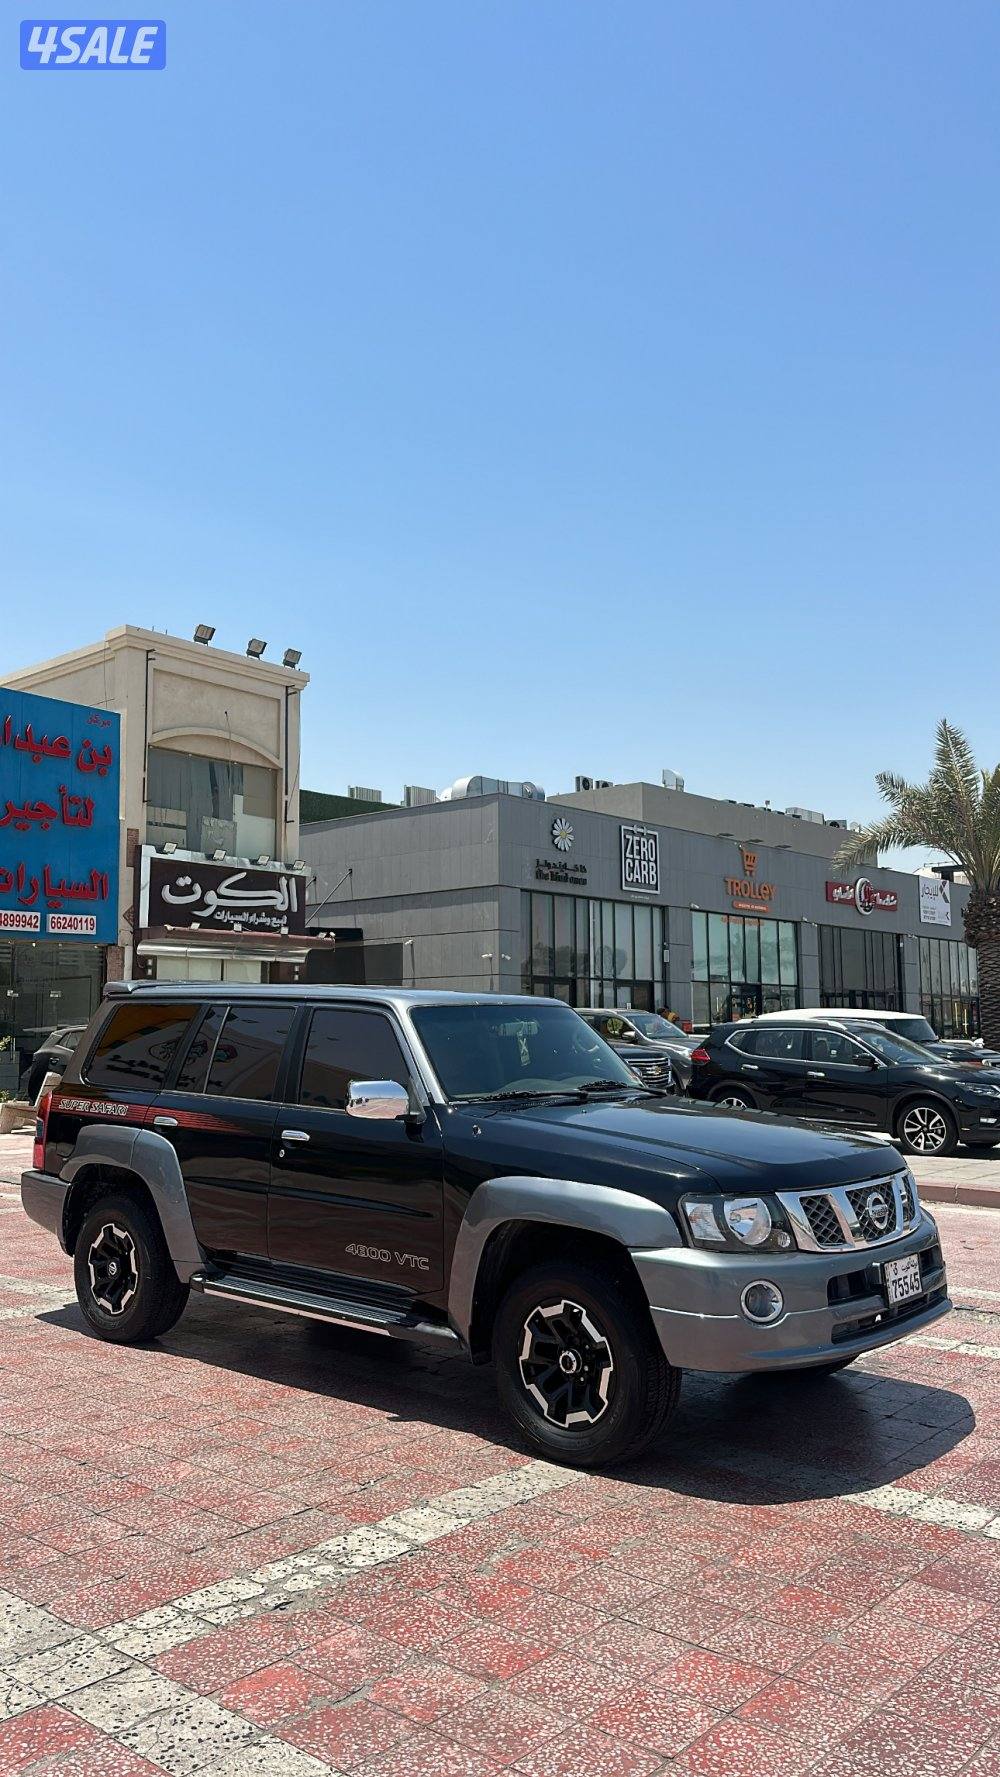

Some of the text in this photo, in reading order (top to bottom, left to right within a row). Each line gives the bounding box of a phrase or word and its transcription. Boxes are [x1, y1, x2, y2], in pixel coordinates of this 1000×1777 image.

[0, 714, 113, 776] بن عبدا
[0, 784, 95, 831] لتأجير
[625, 835, 656, 861] ZERO
[625, 858, 657, 885] CARB
[161, 872, 297, 917] الكوت
[50, 915, 95, 932] 66240119
[213, 909, 249, 923] السيارات
[58, 1099, 129, 1116] SUPER SAFARI
[345, 1243, 430, 1271] 4800 VTC
[891, 1271, 920, 1299] 75545
